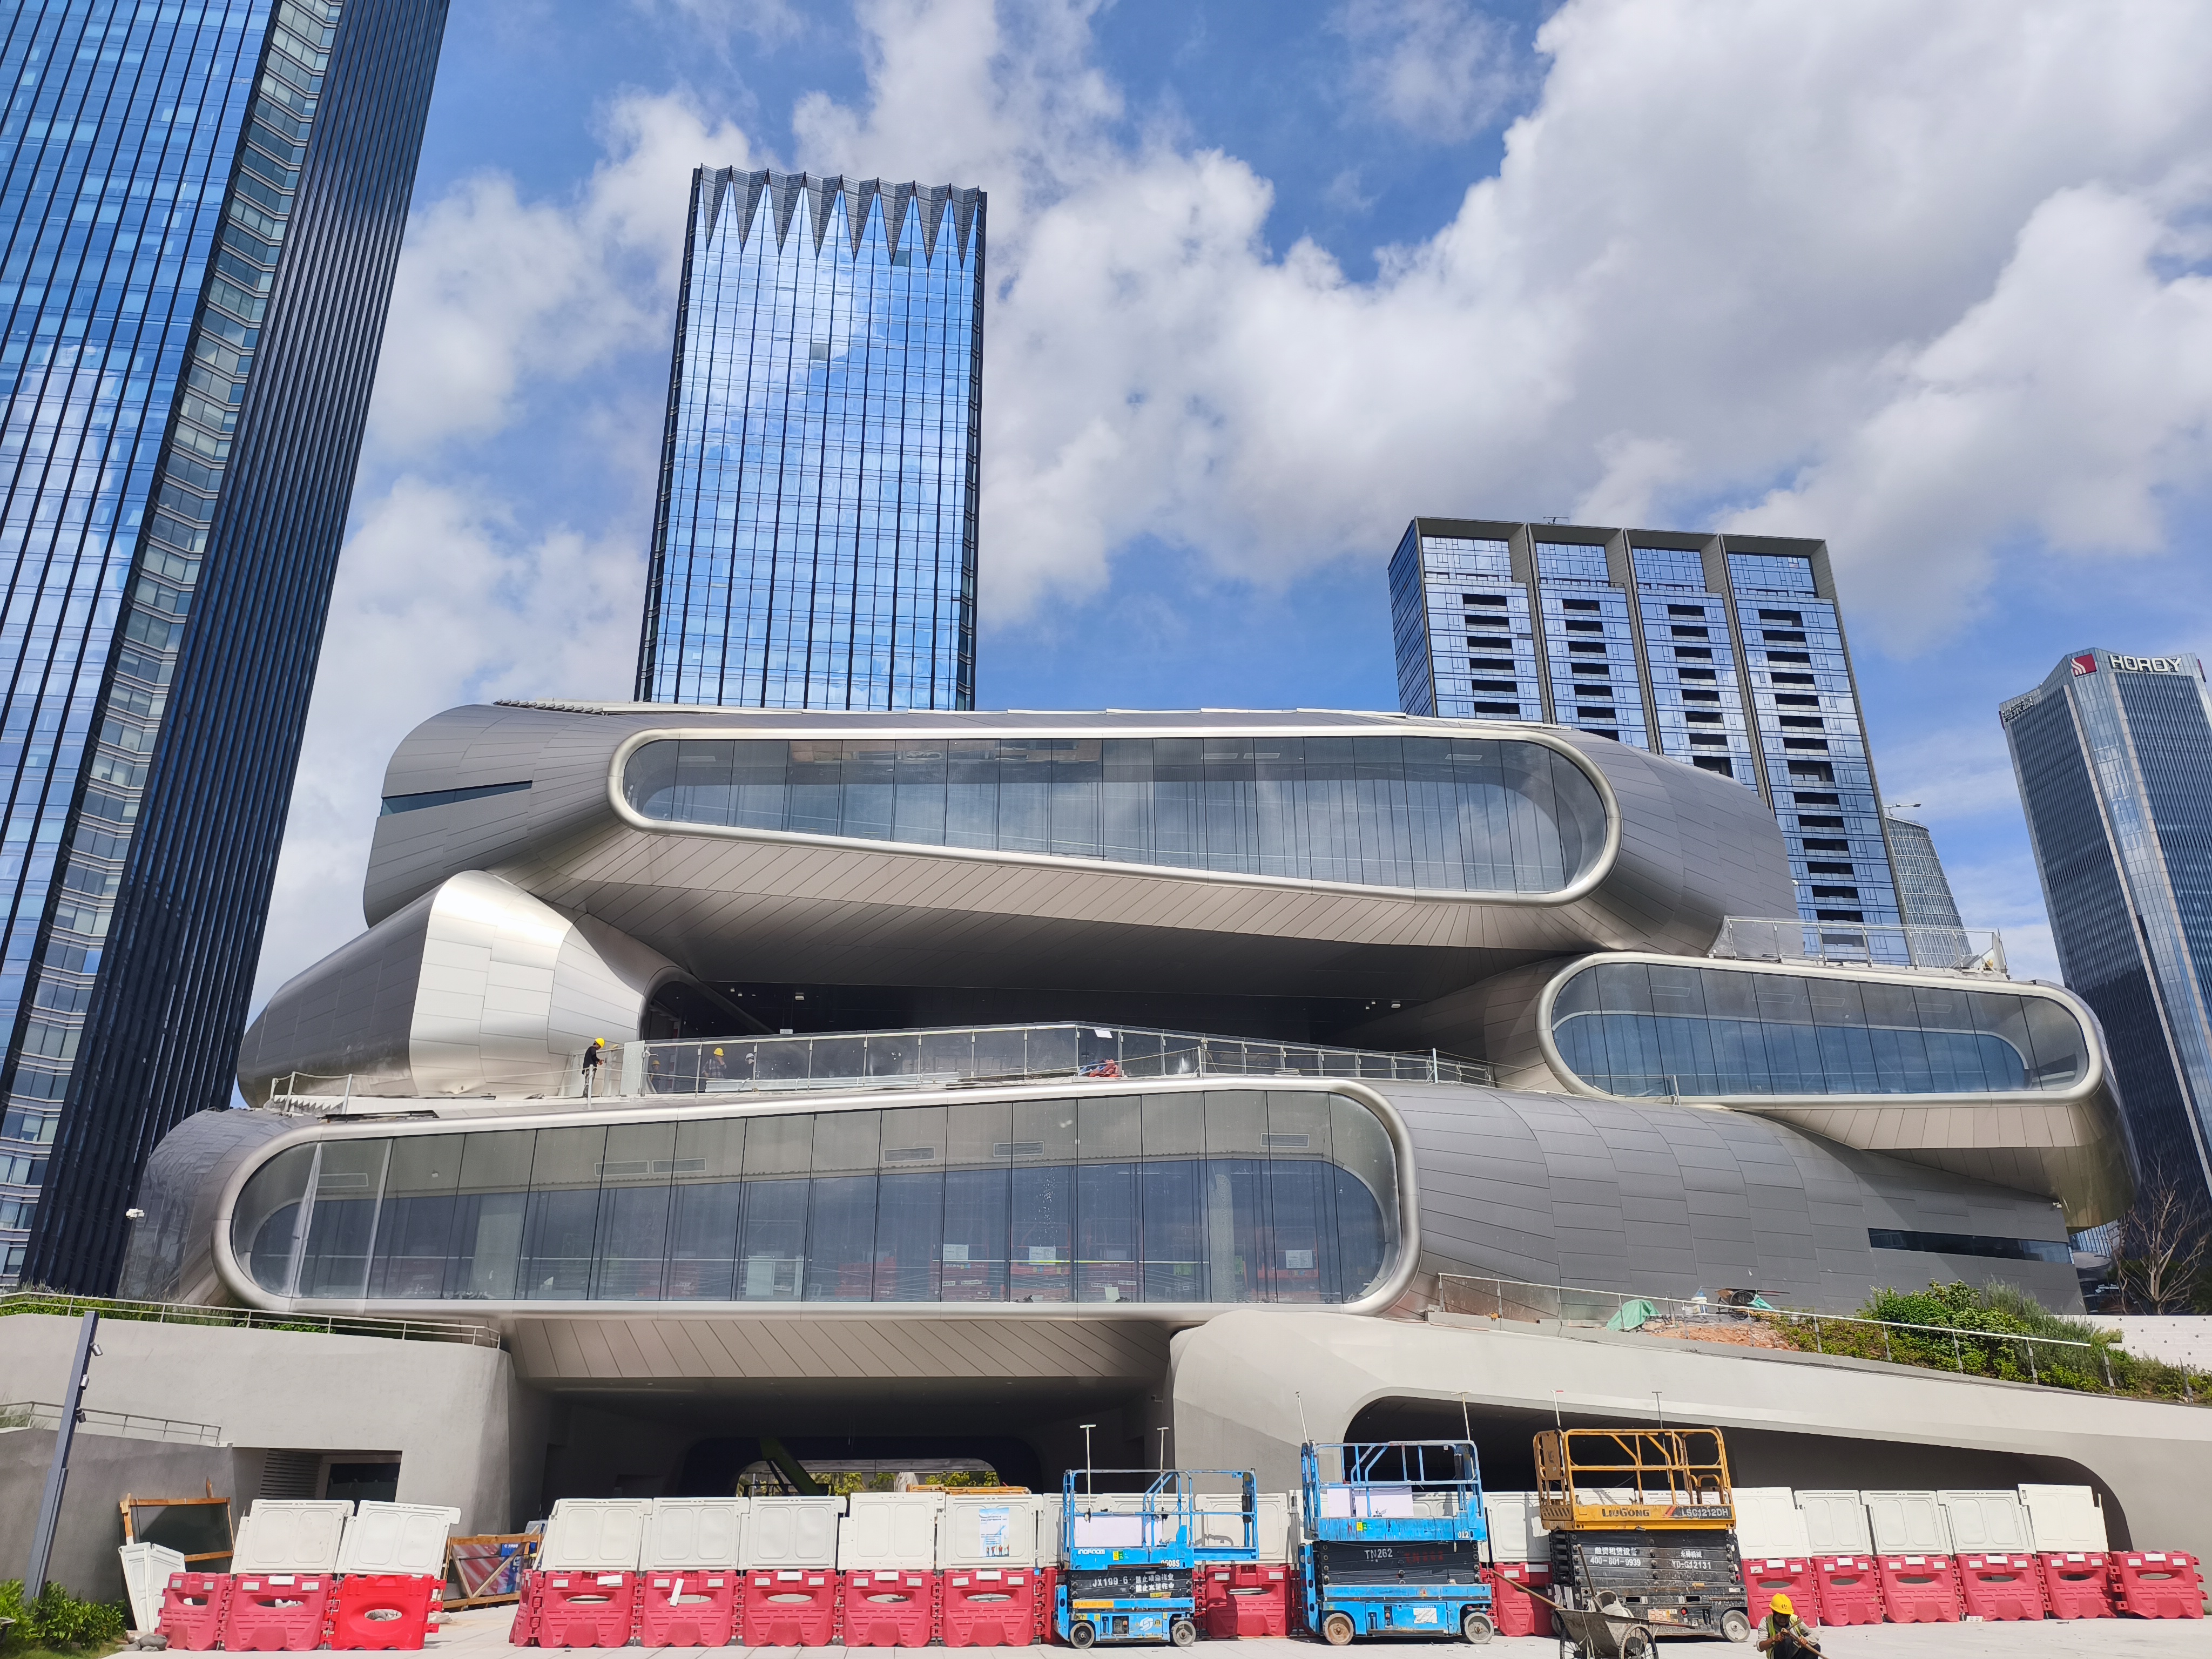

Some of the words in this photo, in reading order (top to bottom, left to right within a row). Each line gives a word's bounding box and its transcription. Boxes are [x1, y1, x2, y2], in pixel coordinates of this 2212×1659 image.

[2109, 655, 2182, 672] HOROY
[1364, 1548, 1393, 1559] TN262
[1590, 1556, 1641, 1566] 400-801-9939
